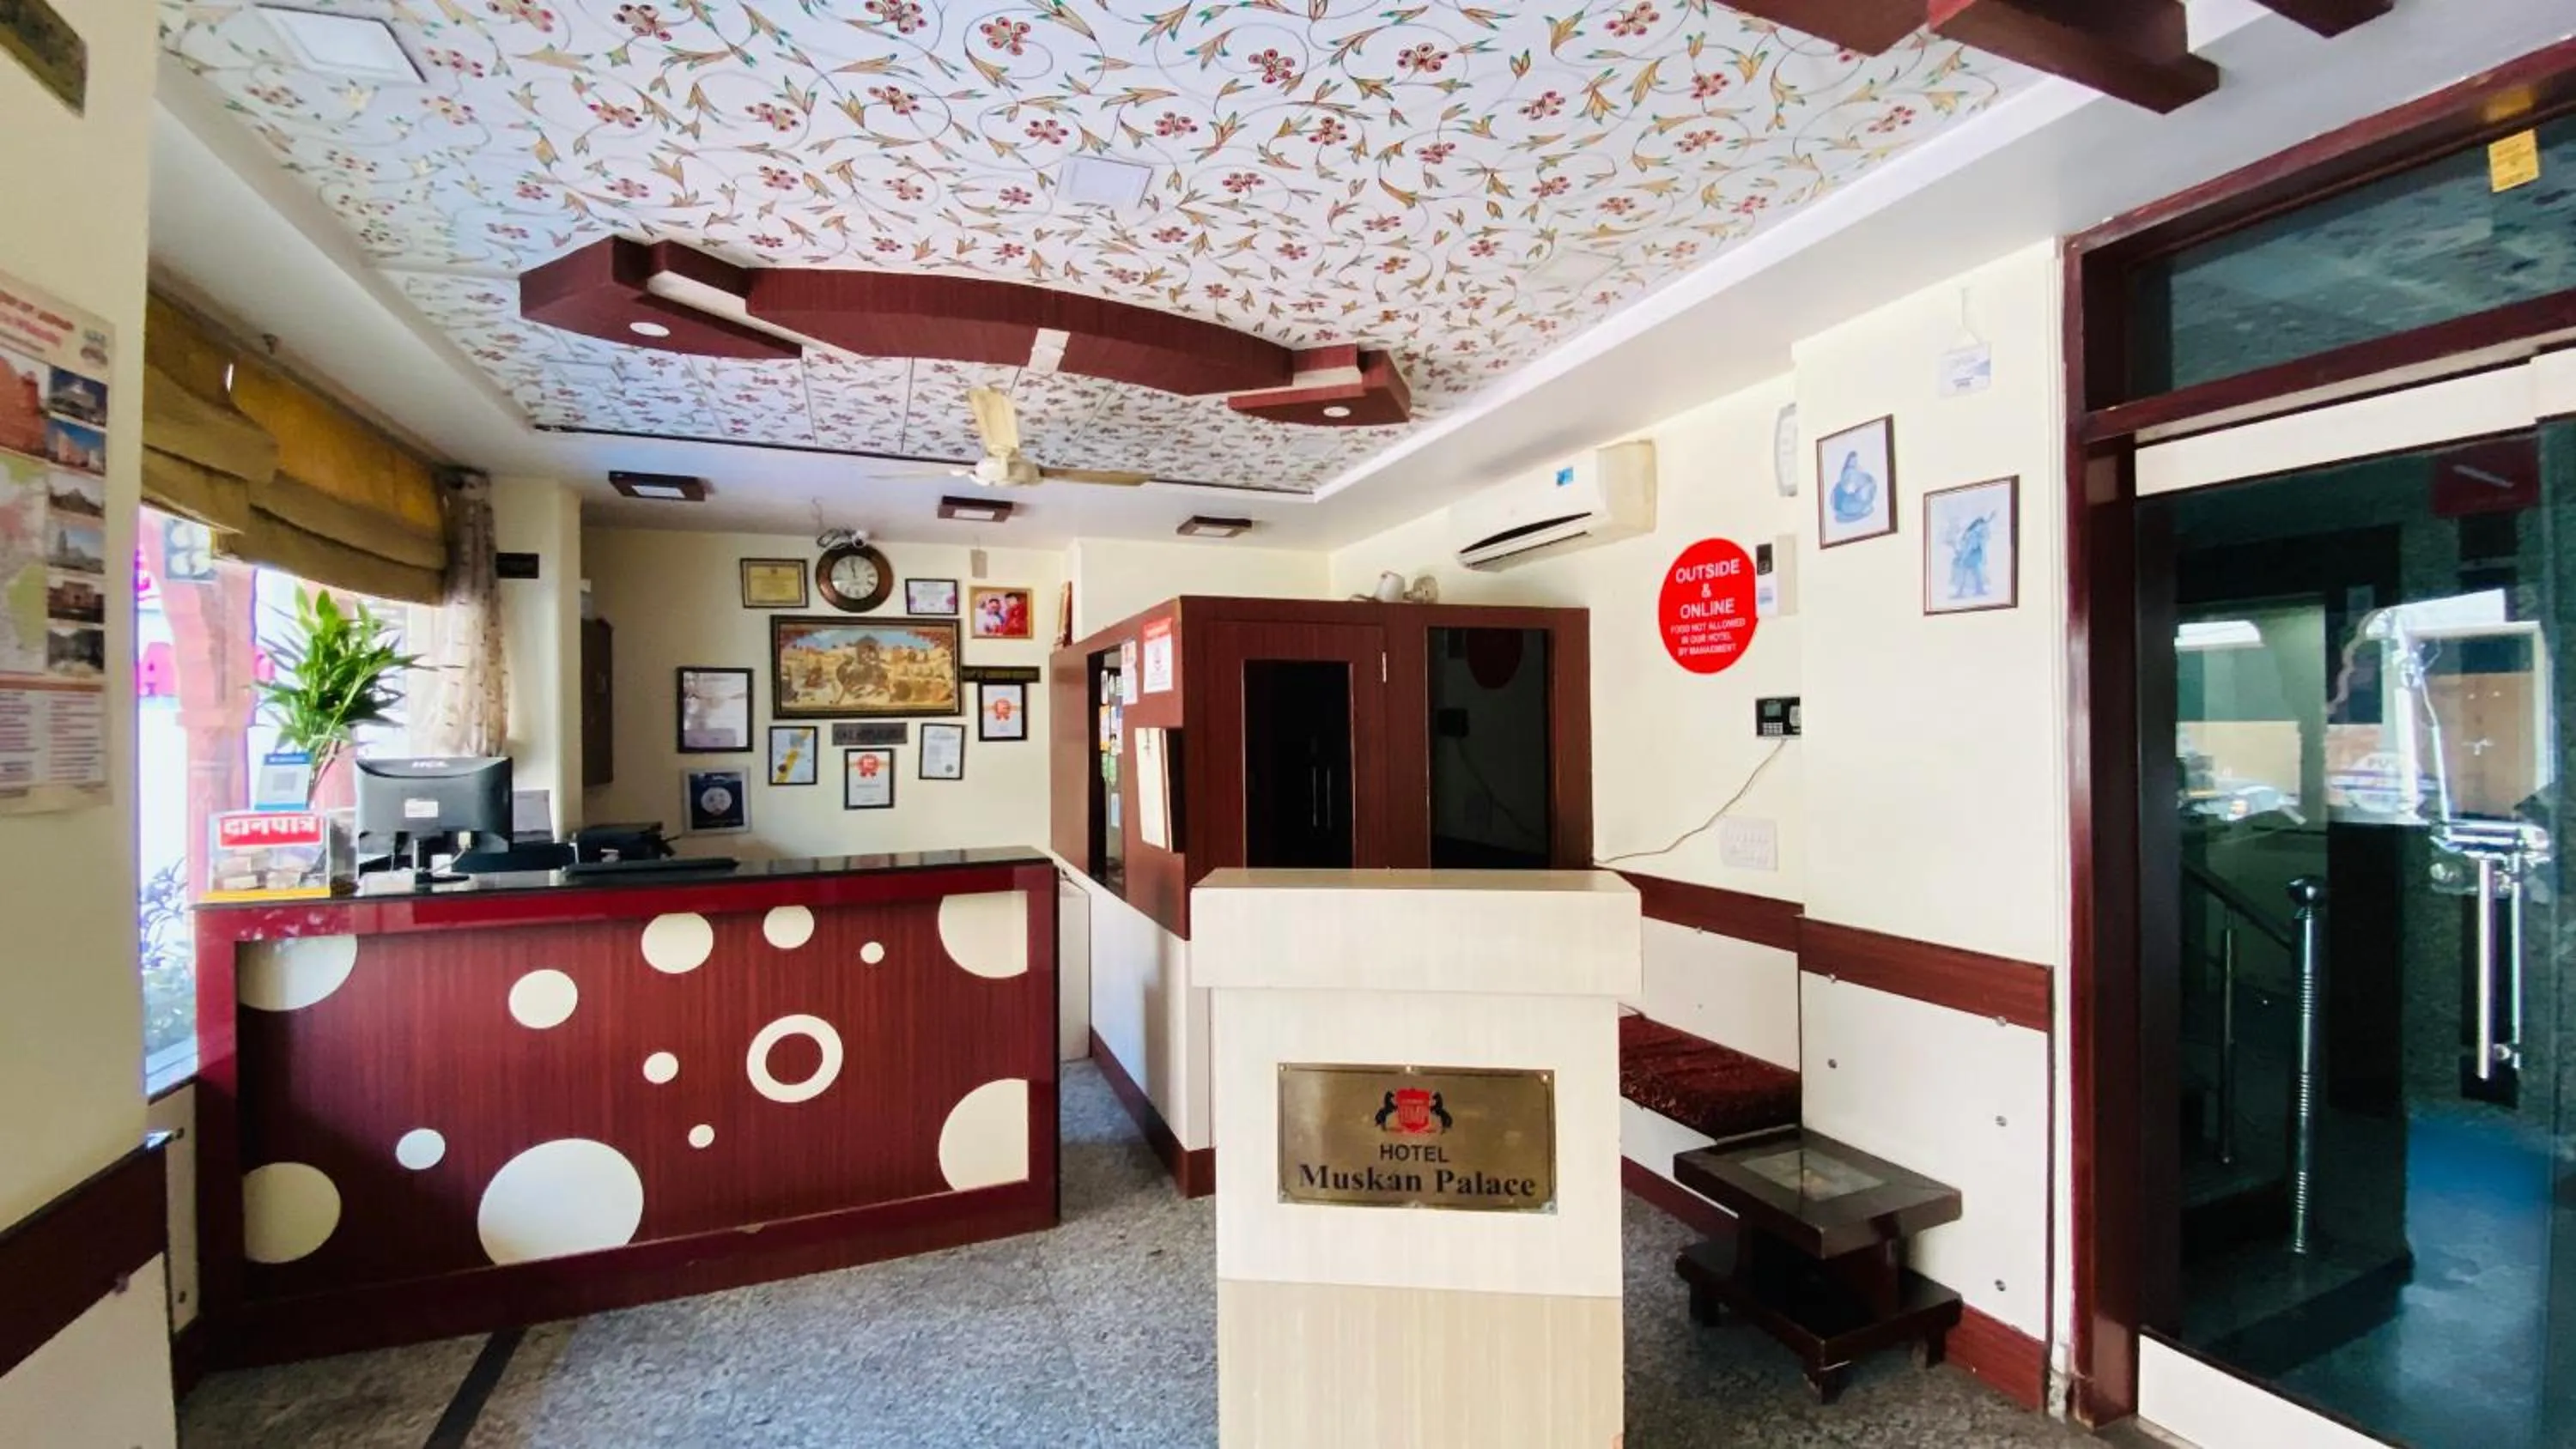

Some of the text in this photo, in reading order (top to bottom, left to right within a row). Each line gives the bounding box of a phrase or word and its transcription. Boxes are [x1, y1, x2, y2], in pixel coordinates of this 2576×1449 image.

[1675, 558, 1741, 584] OUTSIDE
[1701, 583, 1712, 598] &
[1680, 597, 1735, 619] ONLINE
[1692, 622, 1707, 633] NOT
[1709, 617, 1747, 631] ALLOWED
[224, 816, 317, 836] दानपात्र
[1380, 1143, 1449, 1162] HOTEL
[1298, 1163, 1535, 1197] Muskan Palace
